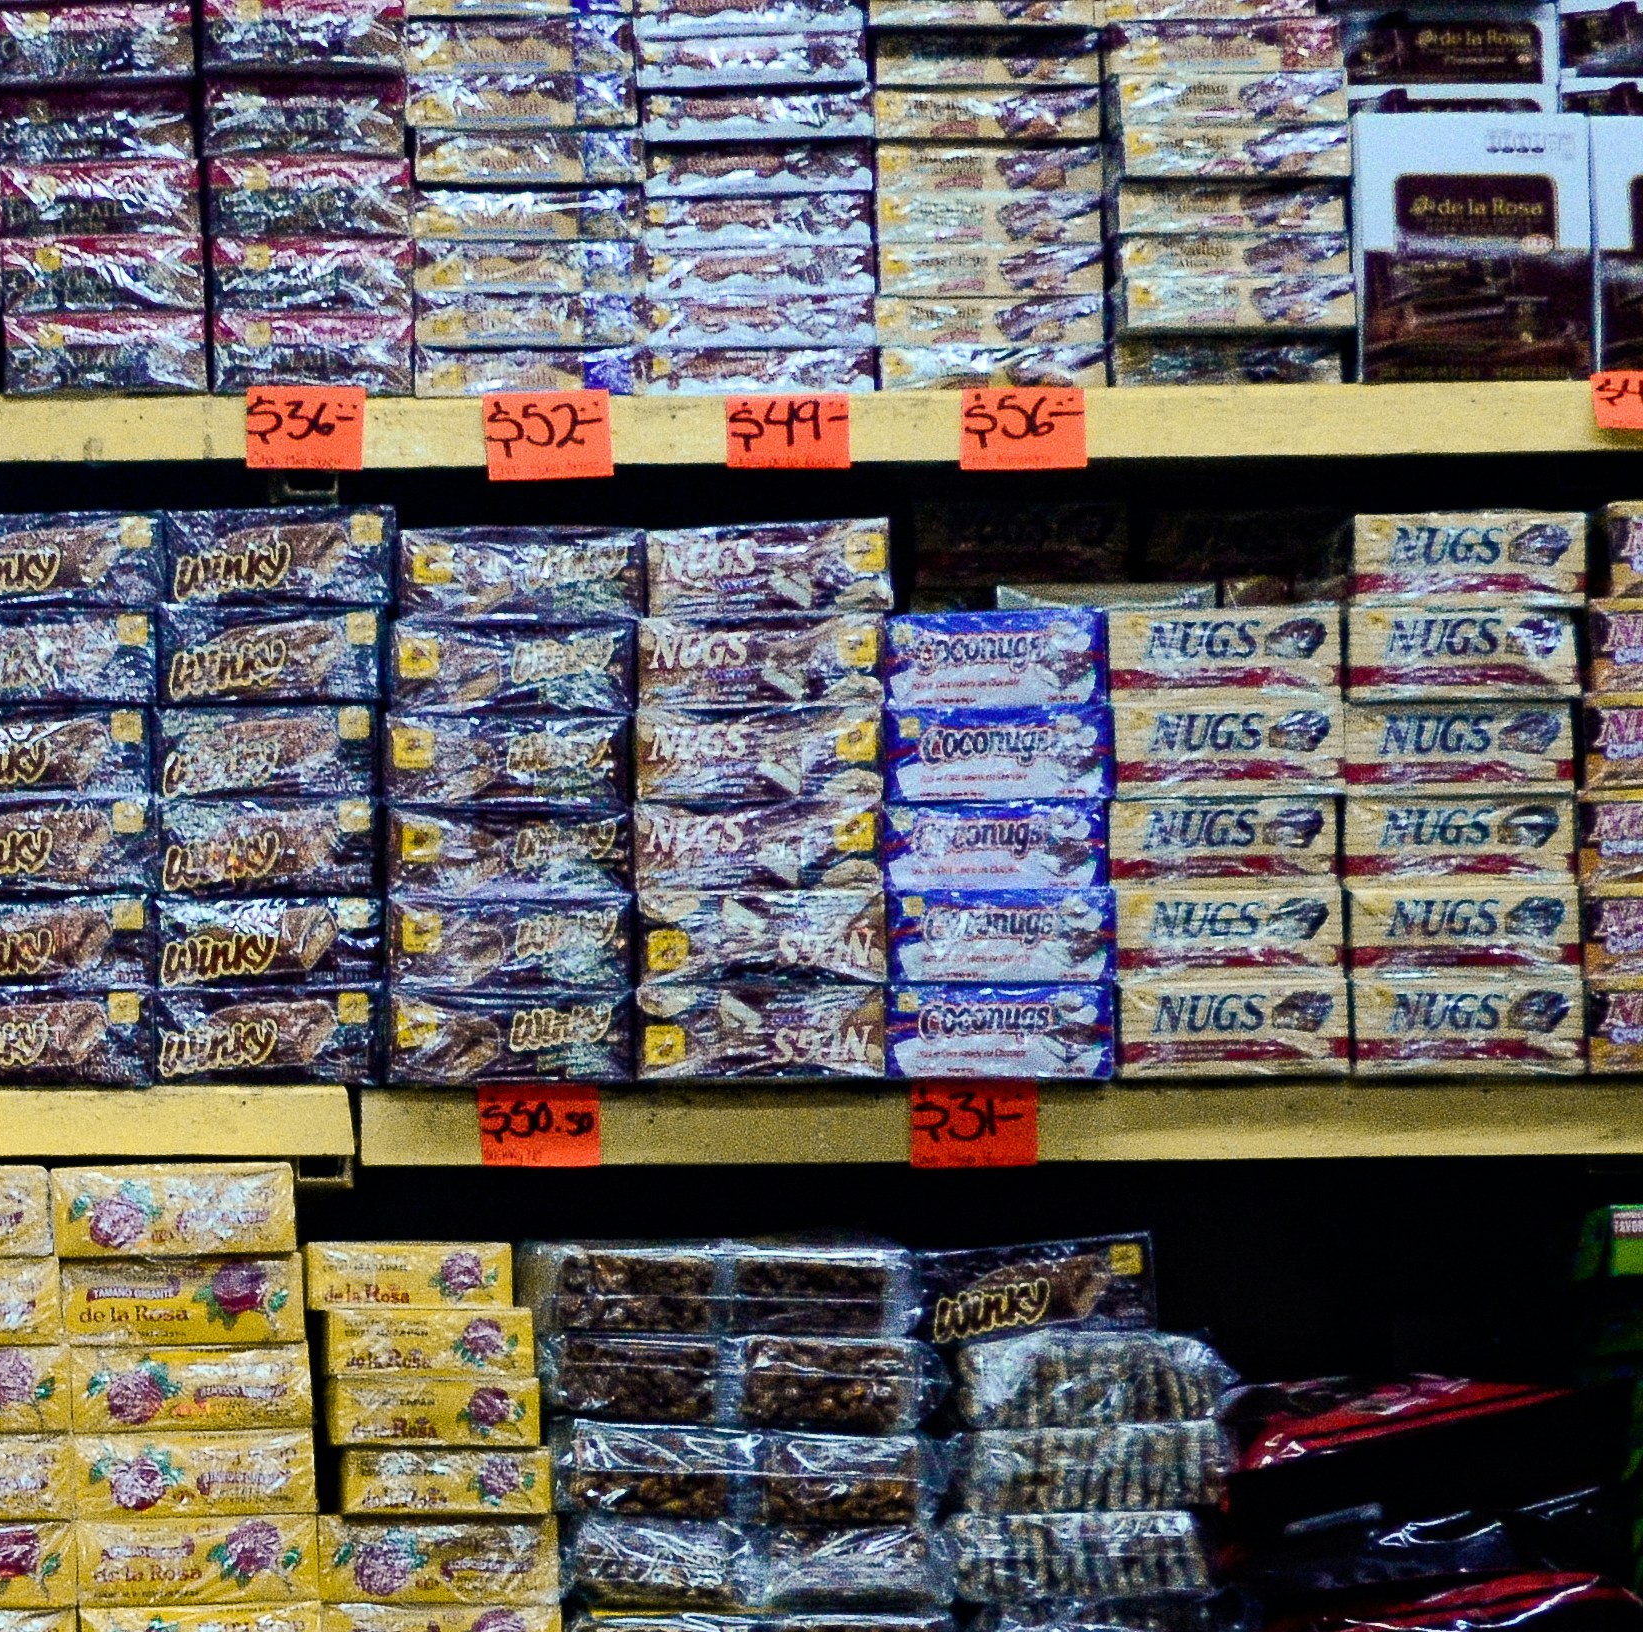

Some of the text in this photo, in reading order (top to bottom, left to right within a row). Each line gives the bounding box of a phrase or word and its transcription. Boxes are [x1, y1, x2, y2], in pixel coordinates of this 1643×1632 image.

[1492, 197, 1544, 215] Rosa
[1393, 526, 1502, 565] NUGS
[649, 630, 749, 668] NUGS
[1148, 620, 1262, 658] NUGS
[1388, 618, 1500, 655] NUGS
[1149, 712, 1263, 751] NUGS
[1379, 714, 1493, 754] NUGS
[1145, 810, 1257, 848] NUGS
[1380, 807, 1493, 846] NUGS
[1149, 900, 1263, 939] NUGS
[1388, 898, 1498, 937] NUGS
[160, 934, 276, 985] Winky
[1155, 993, 1265, 1032] NUGS
[1391, 991, 1500, 1030] NUGS
[111, 1305, 133, 1323] la
[137, 1304, 189, 1323] Rosa
